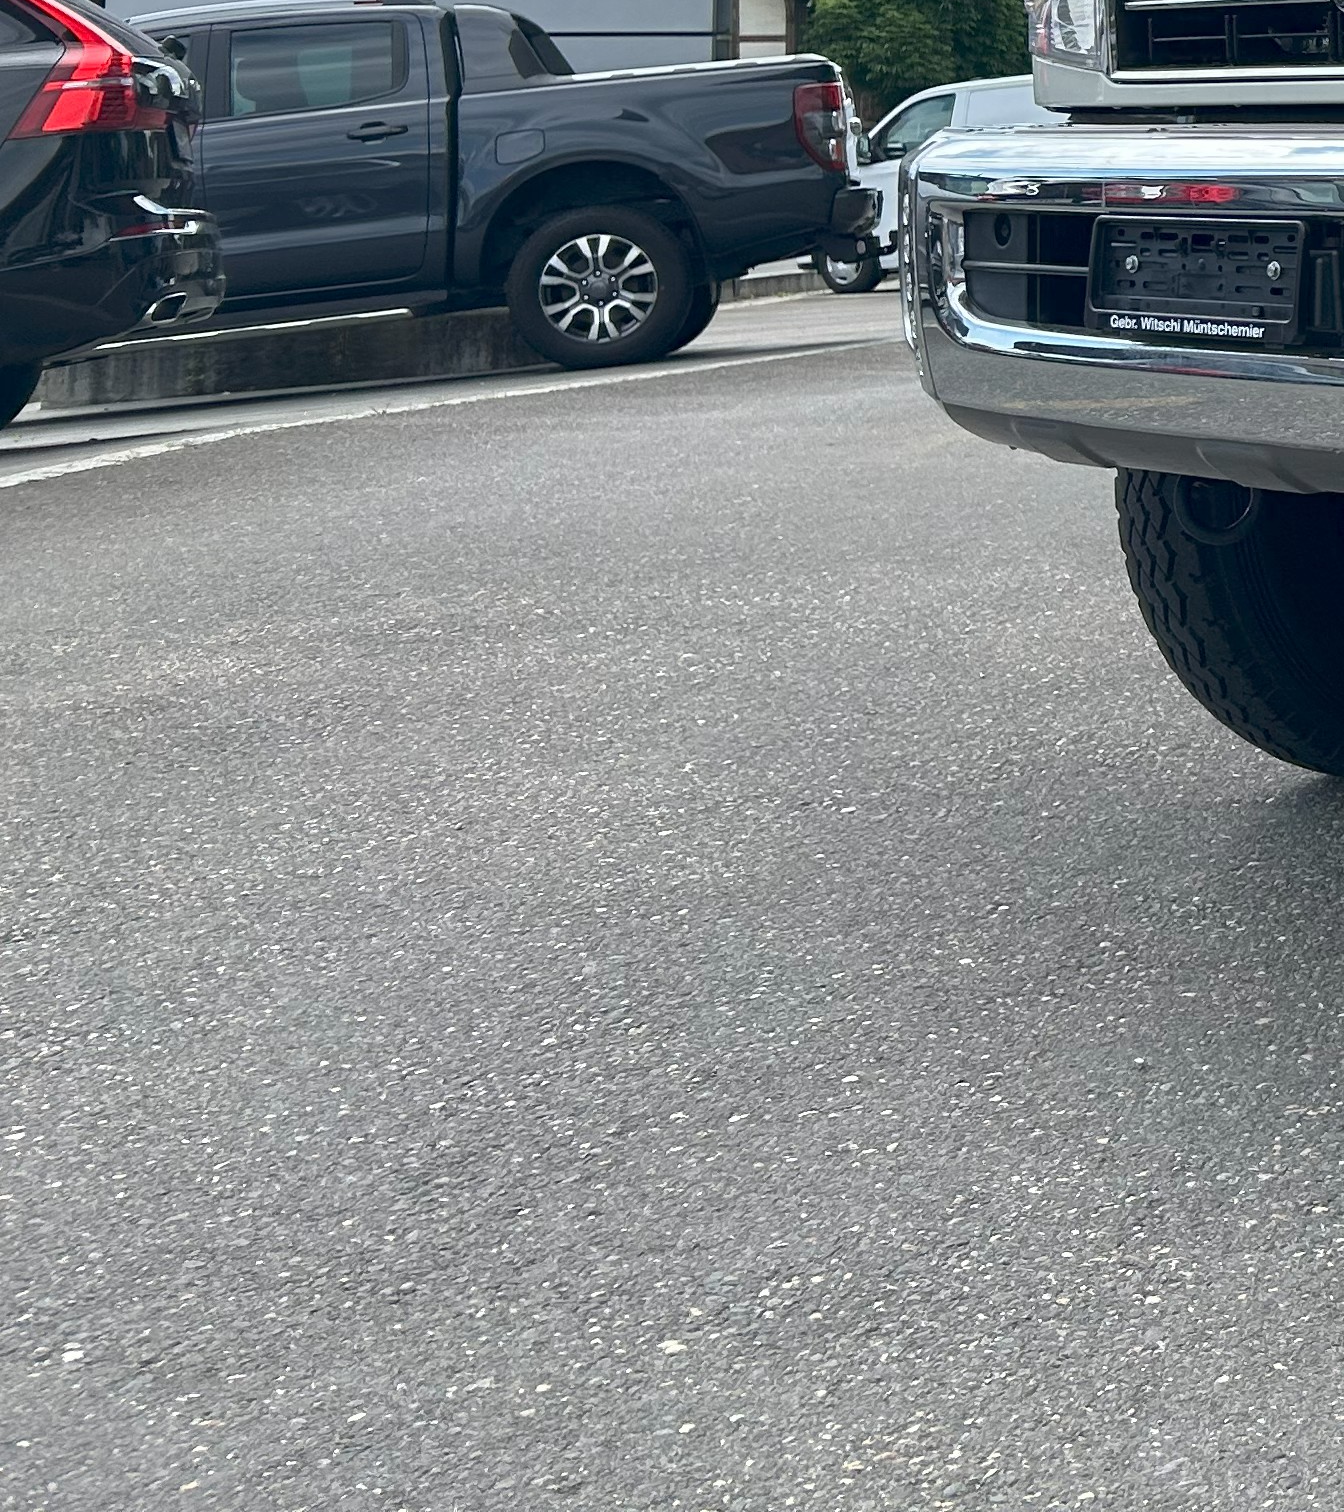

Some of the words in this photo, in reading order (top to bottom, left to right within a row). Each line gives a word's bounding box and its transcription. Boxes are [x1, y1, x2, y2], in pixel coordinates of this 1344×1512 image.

[1110, 314, 1138, 330] Gebr.
[1141, 317, 1181, 333] Witschi
[1183, 320, 1266, 339] Müntschemier
